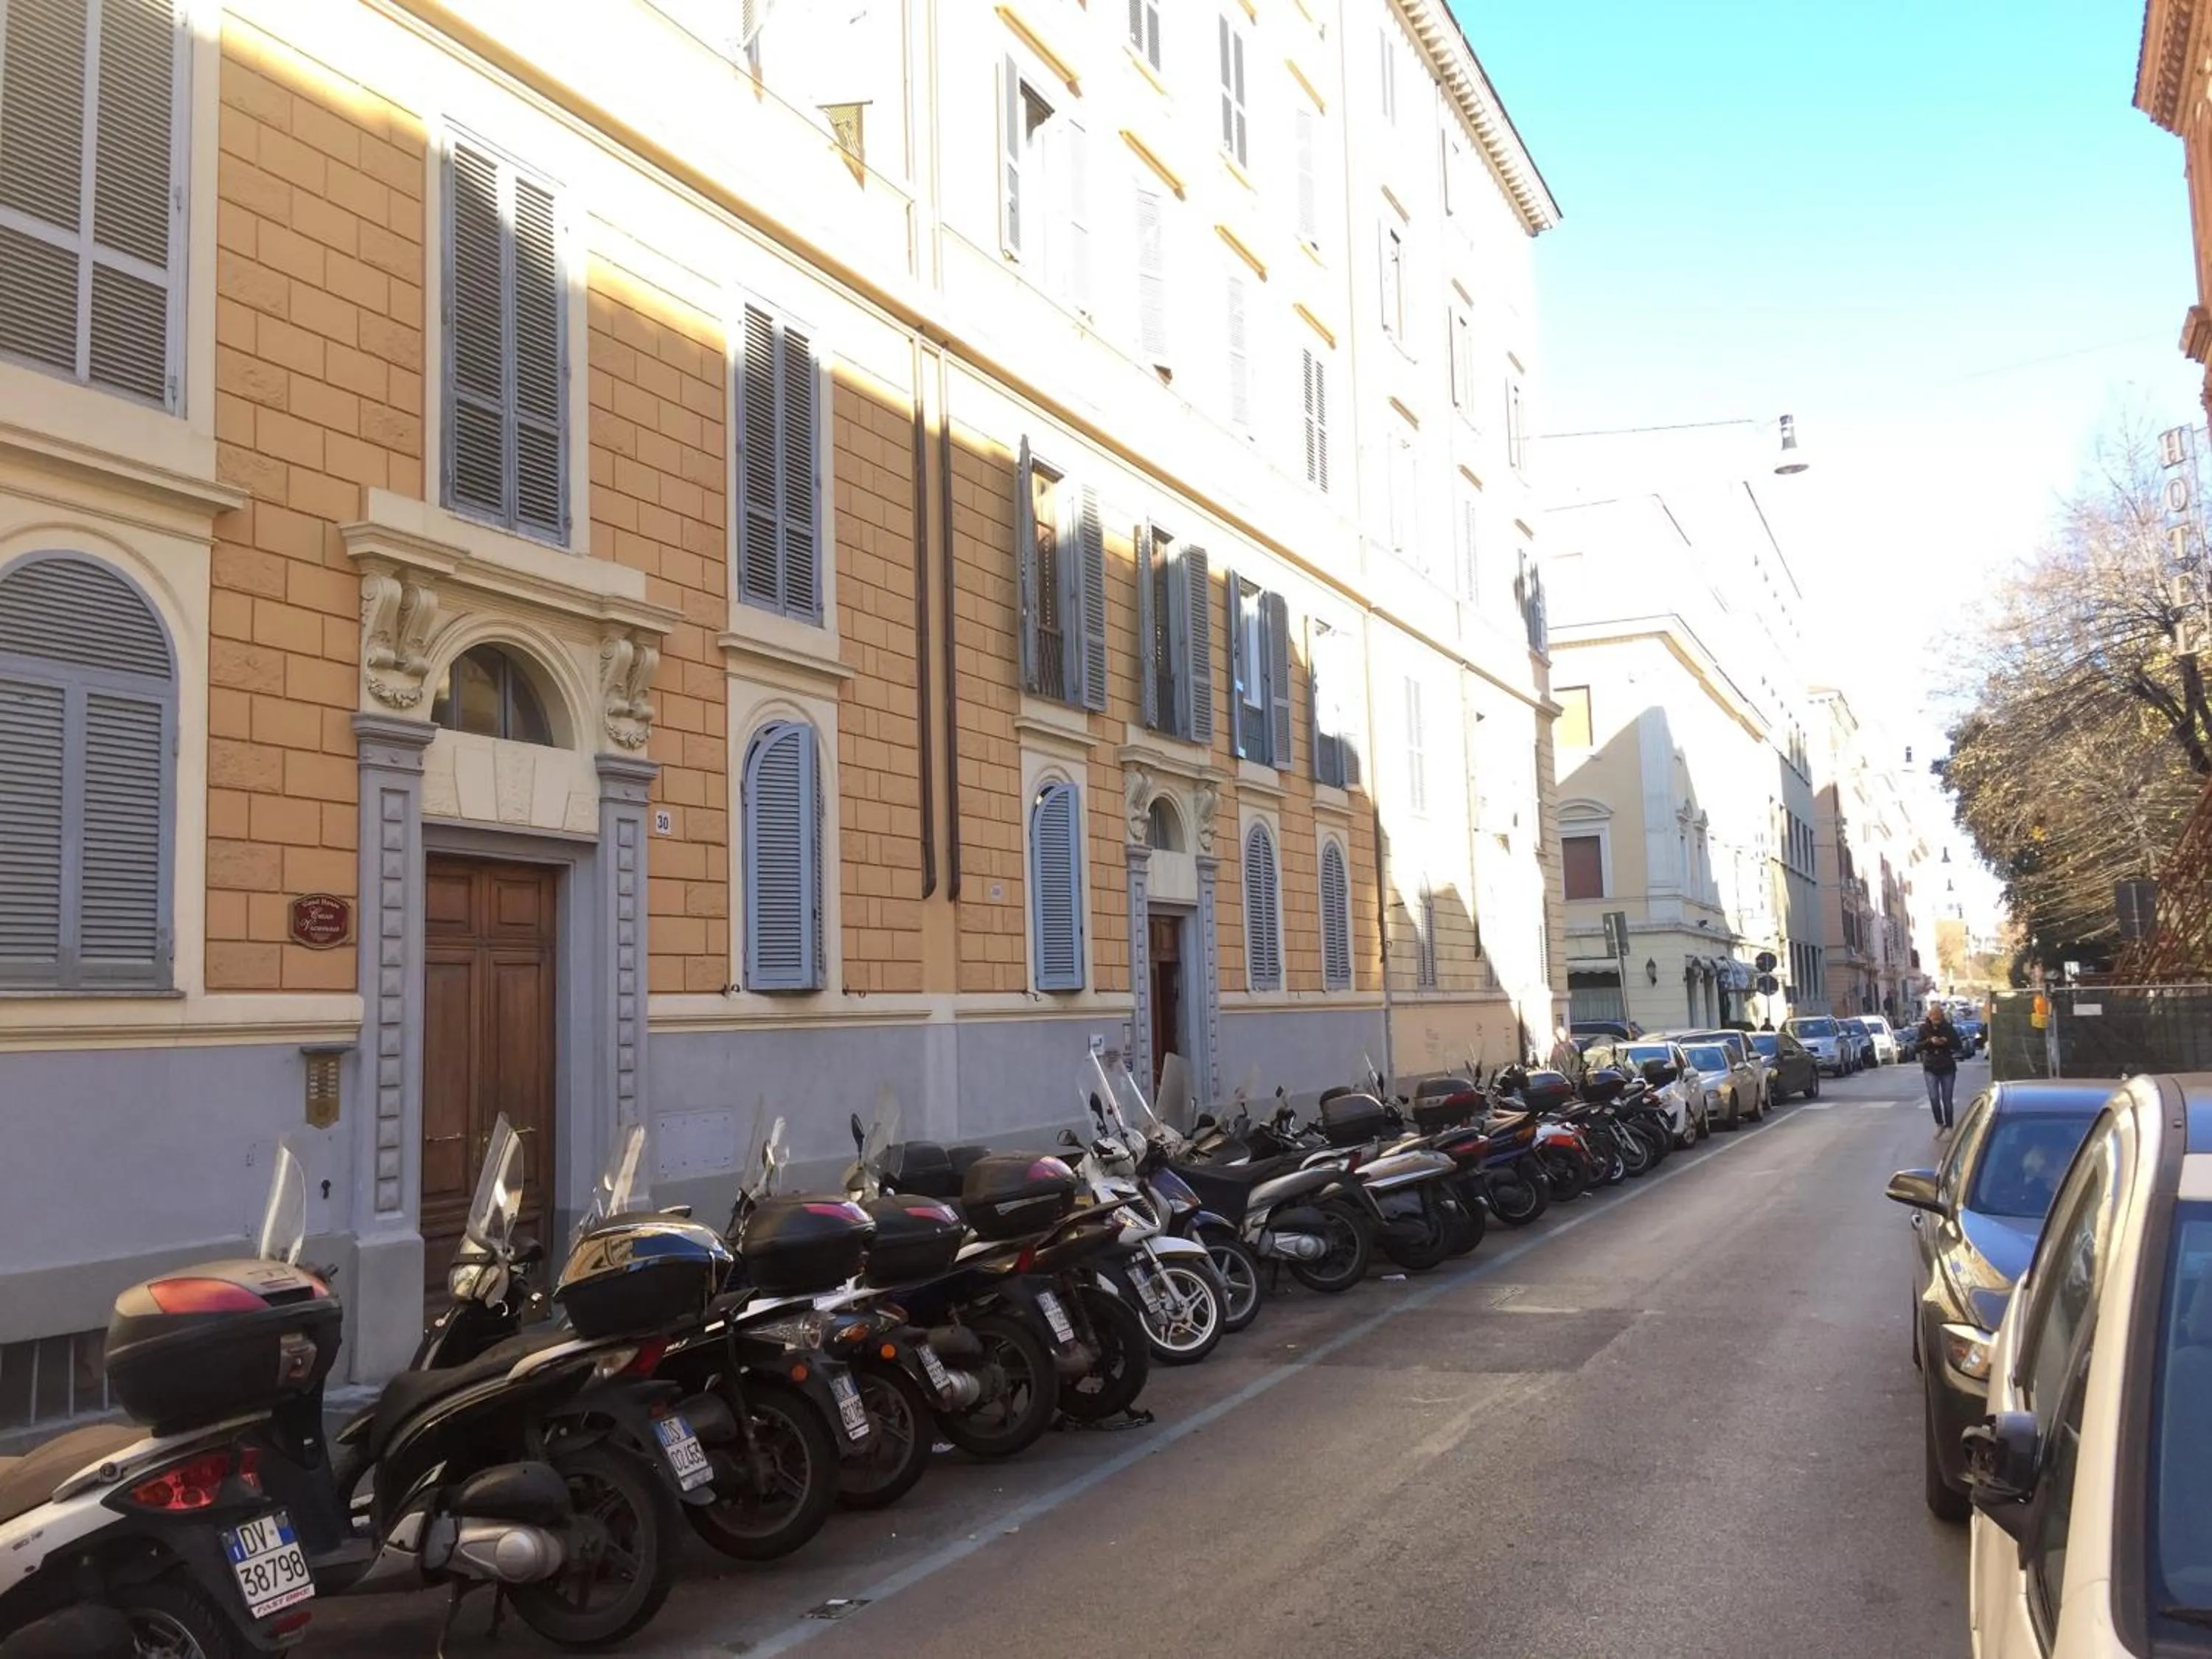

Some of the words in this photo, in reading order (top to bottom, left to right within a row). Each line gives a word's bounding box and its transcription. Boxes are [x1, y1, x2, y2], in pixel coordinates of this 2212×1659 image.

[2158, 425, 2199, 655] HOTEL
[657, 814, 669, 830] 30
[240, 1521, 268, 1554] DV
[240, 1551, 305, 1596] 38798
[257, 1597, 284, 1614] FAST
